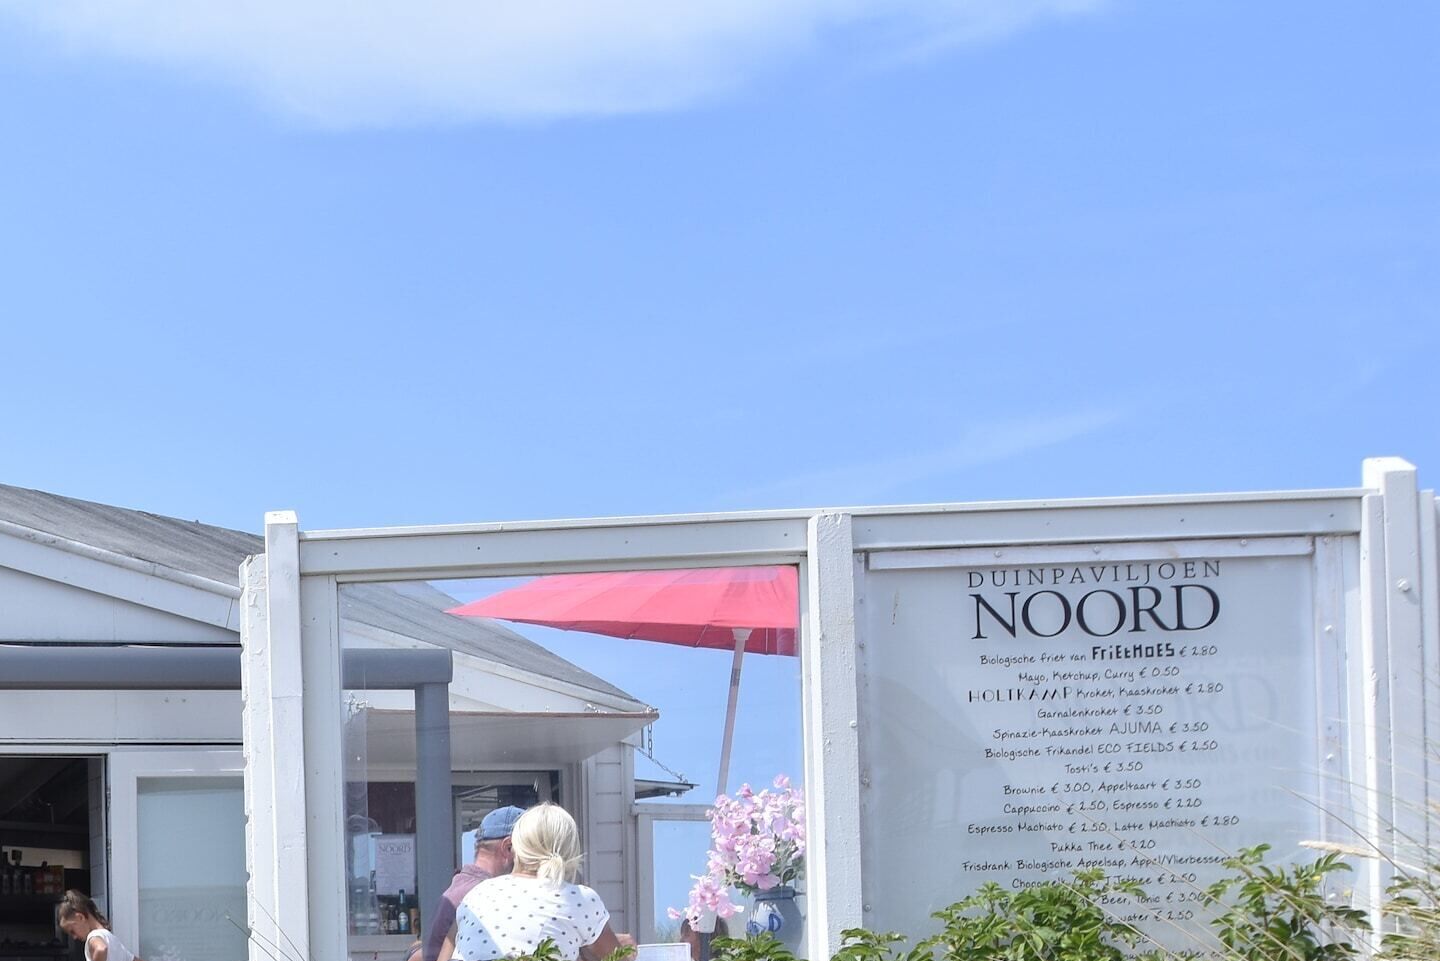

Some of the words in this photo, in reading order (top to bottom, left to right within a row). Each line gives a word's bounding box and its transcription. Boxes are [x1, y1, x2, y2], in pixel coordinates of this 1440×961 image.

[967, 560, 1221, 589] DUINPAVILJOEN
[968, 584, 1221, 640] NOORD
[980, 655, 1036, 667] Biologische
[1040, 652, 1065, 664] friet
[1070, 653, 1087, 662] van
[1179, 646, 1187, 657] €
[1018, 671, 1049, 685] Mayo,
[1052, 671, 1101, 682] Ketchup,
[1105, 668, 1134, 682] Curry
[1139, 667, 1147, 678] €
[968, 686, 1072, 703] HOLTKAMP
[1076, 687, 1115, 698] Kroket,
[1119, 686, 1180, 697] Kaaskroket
[1185, 683, 1193, 694] €
[1037, 704, 1118, 719] Garnalenkroket
[1123, 704, 1131, 715] €
[992, 726, 1103, 741] Spinazie-Kaaskroket
[1109, 720, 1162, 735] AJUMA
[1169, 722, 1177, 733] €
[985, 748, 1041, 760] Biologische
[1046, 744, 1094, 756] Frikandel
[1097, 743, 1121, 754] ECO
[1126, 741, 1174, 752] FIELDS
[1179, 740, 1187, 752] €
[1065, 763, 1098, 774] Tosti's
[1104, 762, 1111, 773] €
[1003, 784, 1046, 795] Brownie
[1051, 782, 1059, 793] €
[1098, 780, 1157, 793] Appeltaart
[1162, 779, 1170, 790] €
[1003, 803, 1060, 815] Cappuccino
[1067, 803, 1075, 815] €
[1113, 799, 1159, 812] Espresso
[1164, 798, 1172, 809] €
[967, 823, 1013, 836] Espresso
[1018, 821, 1064, 832] Machiato
[1068, 822, 1077, 833] €
[1115, 821, 1144, 831] Latte
[1201, 816, 1209, 827] €
[1050, 841, 1083, 852] Pukka
[1087, 841, 1112, 851] Thee
[1016, 859, 1072, 872] Biologische
[1077, 856, 1127, 869] Appelsap,
[1158, 873, 1166, 884] €
[1101, 894, 1130, 905] Beer,
[1167, 892, 1174, 903] €
